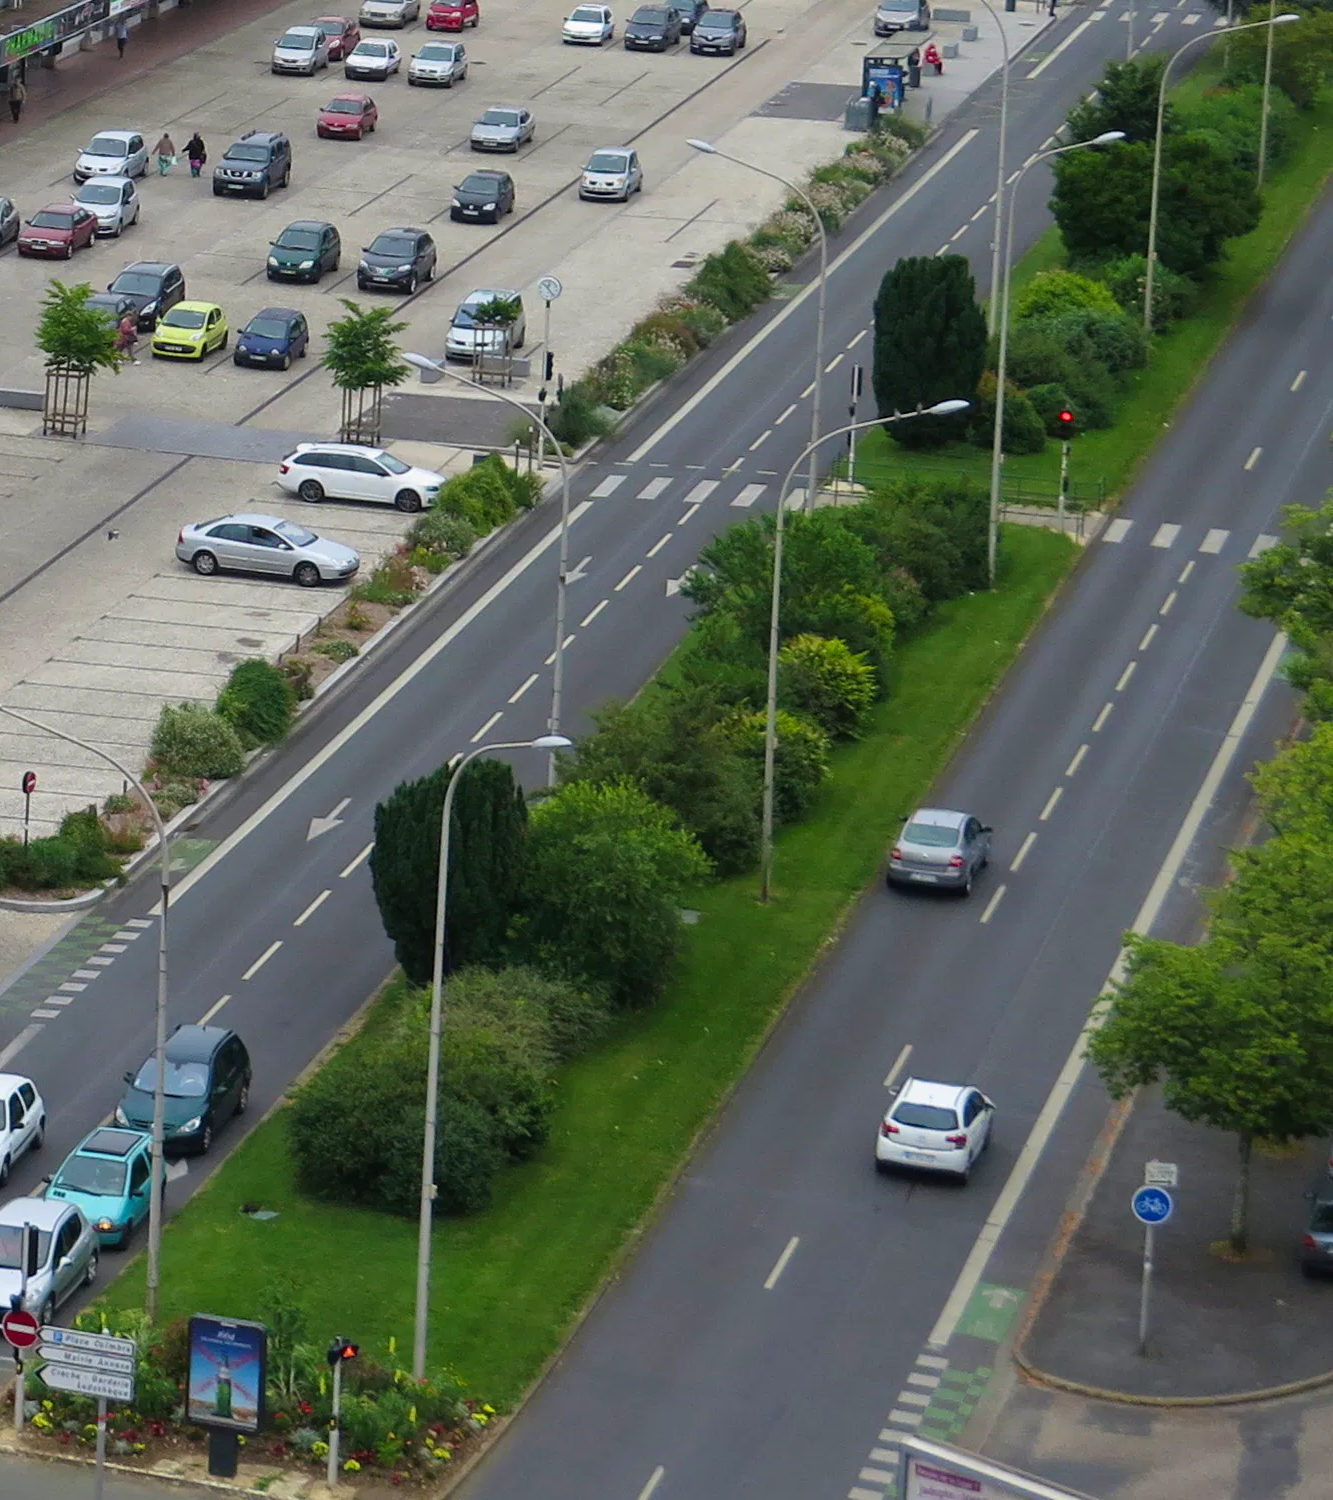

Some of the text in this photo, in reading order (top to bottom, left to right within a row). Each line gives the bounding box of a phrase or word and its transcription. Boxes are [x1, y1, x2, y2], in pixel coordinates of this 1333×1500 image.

[65, 1335, 89, 1347] Place
[64, 1352, 130, 1370] Mairie Annexe
[92, 1375, 129, 1388] Garderie
